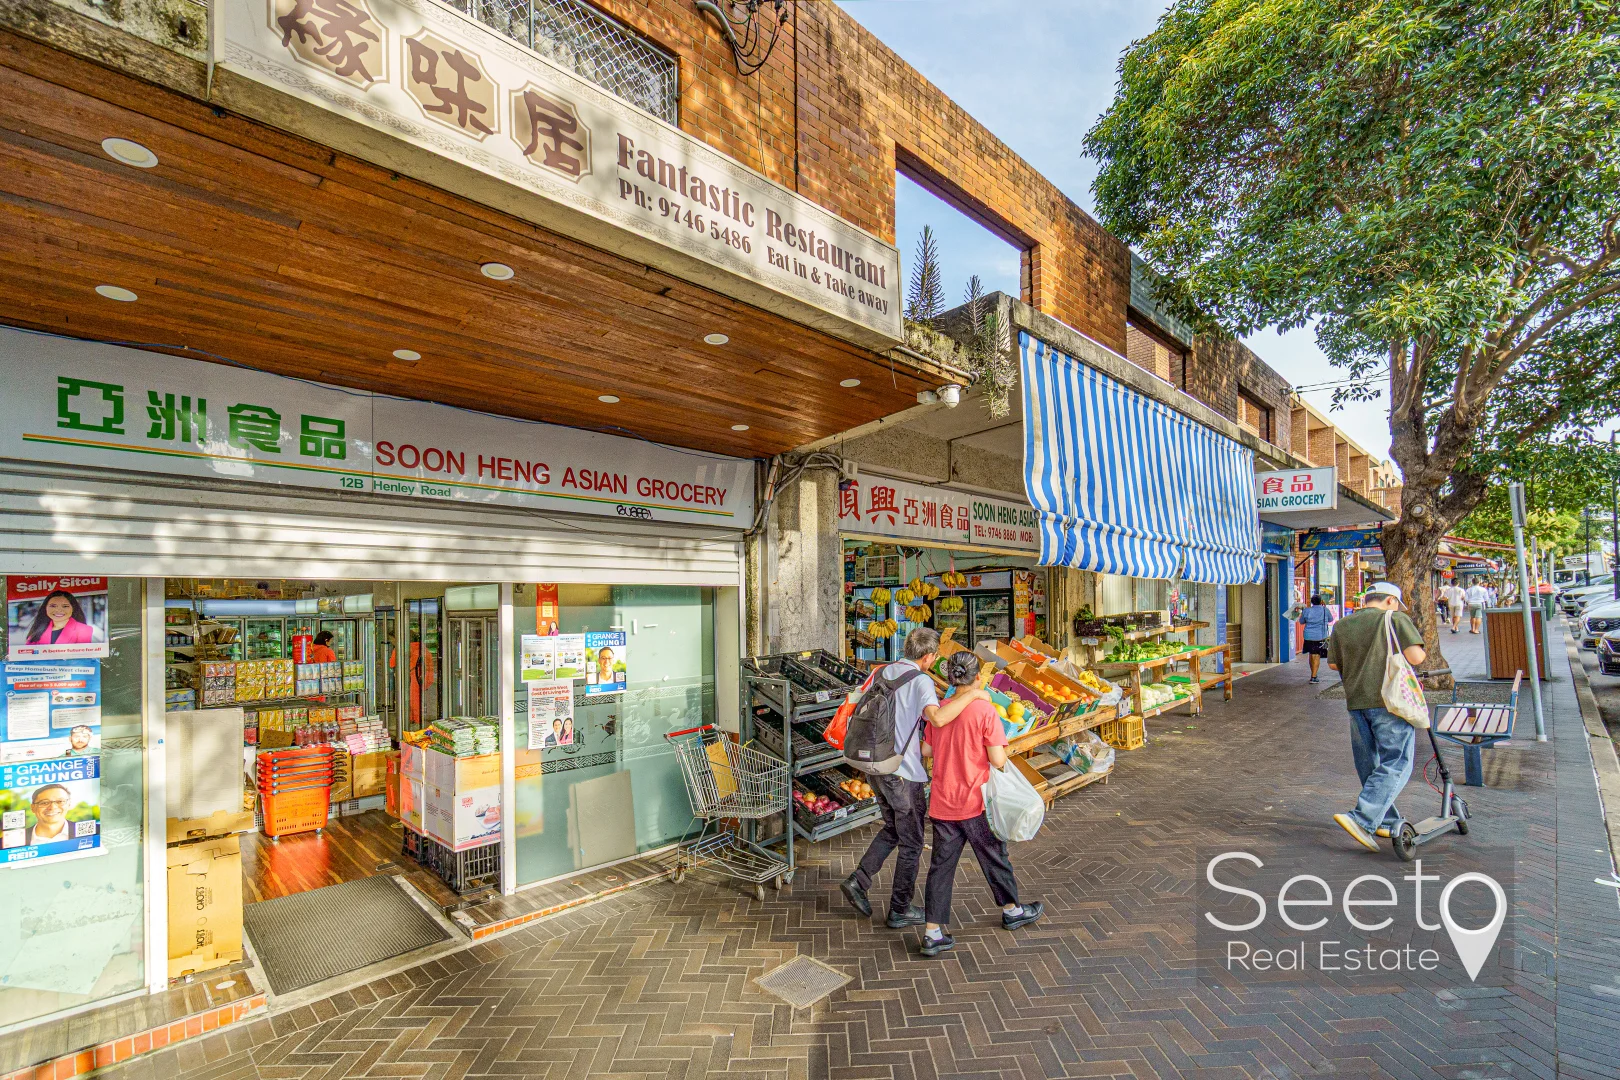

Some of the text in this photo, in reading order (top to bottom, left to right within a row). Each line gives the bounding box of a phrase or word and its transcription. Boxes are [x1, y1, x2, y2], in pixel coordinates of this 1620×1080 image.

[617, 133, 887, 289] Fantastic Restaurant
[620, 177, 752, 254] Ph: 9746 5486
[767, 246, 888, 316] Eat in & Take away
[58, 376, 346, 460] 亞洲食品
[375, 440, 727, 506] SOON HENG ASIAN GROCERY
[340, 477, 451, 497] 12B Henley Road
[1281, 494, 1326, 506] GROCERY
[973, 502, 995, 522] SOON
[998, 505, 1017, 525] HENG
[974, 525, 986, 537] TEL:
[1020, 531, 1033, 543] MOB:
[16, 576, 100, 593] Sally Sitou
[16, 759, 83, 775] GRANGE
[16, 770, 83, 786] CHUNG
[8, 850, 38, 861] REID
